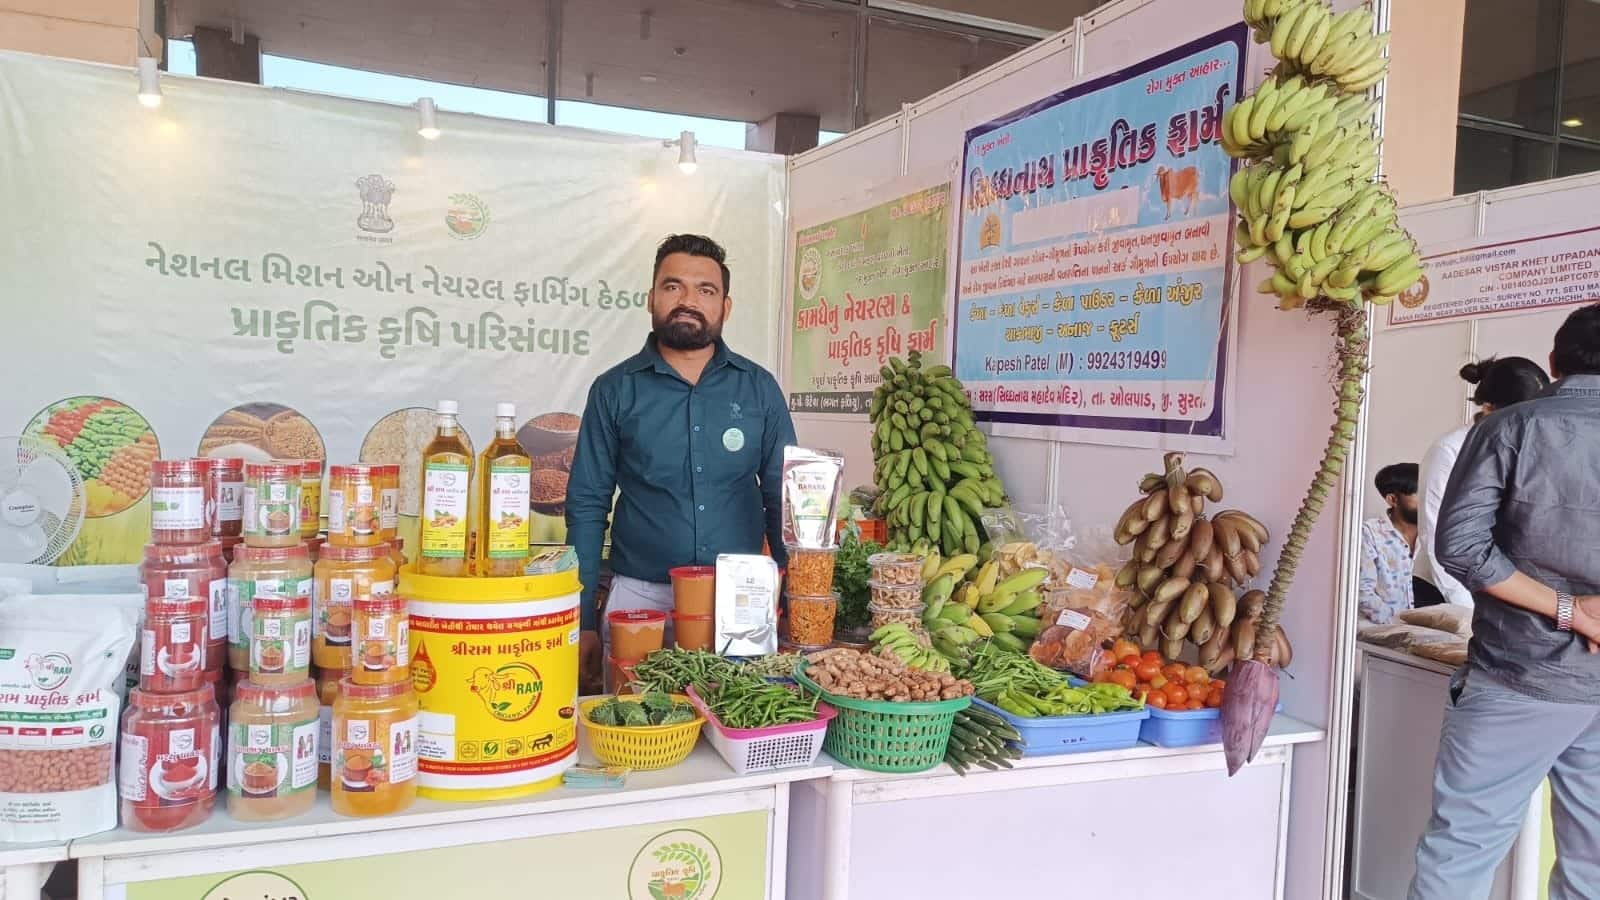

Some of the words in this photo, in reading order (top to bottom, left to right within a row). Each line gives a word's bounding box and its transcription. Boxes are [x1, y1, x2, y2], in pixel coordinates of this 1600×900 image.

[1146, 78, 1162, 96] રોગ
[145, 242, 251, 283] નેશનલ
[262, 252, 344, 288] મિશન
[353, 261, 413, 294] ઓન
[422, 265, 504, 302] નેચરલ
[1442, 267, 1482, 281] AADESAR
[1485, 261, 1519, 274] VISTAR
[1521, 256, 1548, 268] KHET
[1499, 268, 1548, 282] COMPANY
[1550, 260, 1592, 275] LIMITED
[1132, 284, 1162, 306] કેળા
[1465, 295, 1489, 306] OFFICE
[1496, 291, 1527, 302] SURVEY
[231, 300, 368, 354] પ્રાકૃતિક
[377, 305, 440, 359] કૃષિ
[451, 311, 592, 356] પરિસંવાદ
[828, 331, 872, 367] પ્રાકૃતિક
[876, 326, 901, 364] કૃષિ
[1024, 354, 1050, 372] Patel
[1055, 352, 1074, 375] (M)
[1087, 349, 1167, 371] 9924319499
[1031, 386, 1055, 405] મહાદેવ
[450, 641, 491, 655] શ્રીરામ
[498, 639, 541, 657] પ્રાકૃતિક
[546, 633, 562, 649] ફાર્મ
[516, 679, 543, 696] RAM
[24, 691, 69, 710] પ્રાકૃતિક
[76, 689, 101, 704] ફાર્મ
